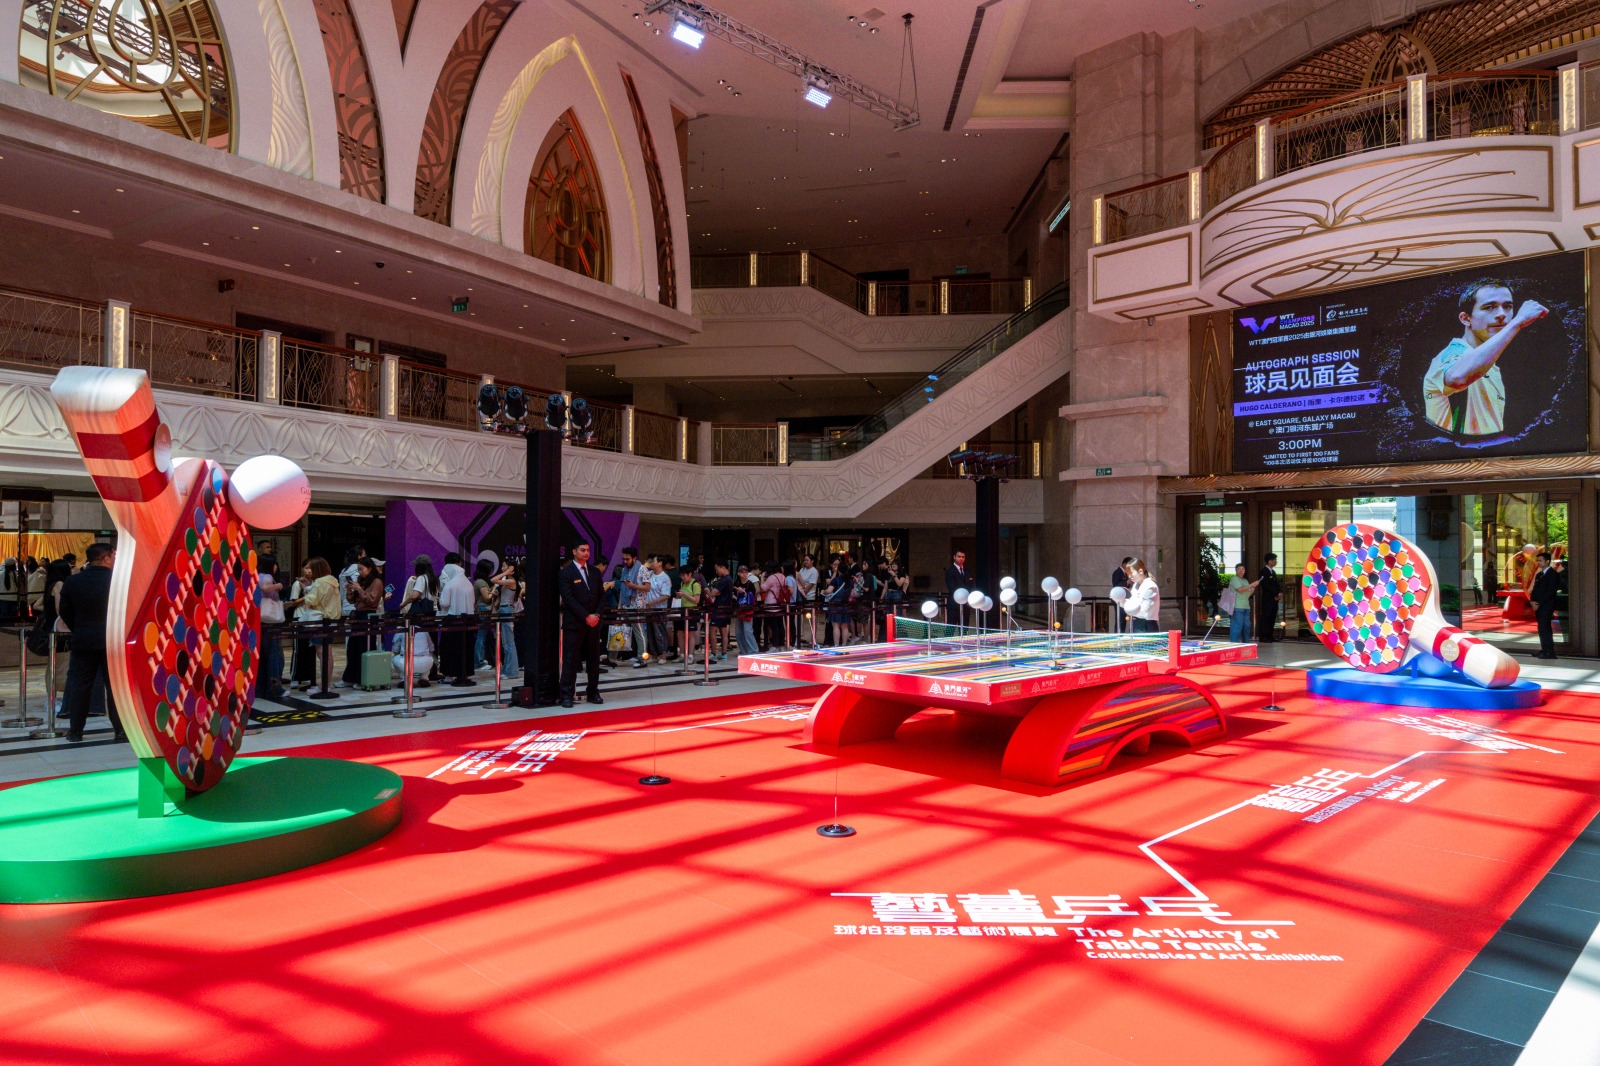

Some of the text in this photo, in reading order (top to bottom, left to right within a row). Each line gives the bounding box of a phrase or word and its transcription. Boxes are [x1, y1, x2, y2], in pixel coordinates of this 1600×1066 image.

[1280, 315, 1315, 324] CHAMPIONS
[1280, 322, 1300, 330] MACAO
[1245, 349, 1360, 372] AUTOGRAPH SESSION
[1244, 362, 1360, 394] 球员见面会
[1240, 400, 1302, 412] HUGO CALDERANO
[1273, 417, 1301, 425] SQUARE,
[1330, 412, 1356, 420] MACAU
[1278, 439, 1322, 450] 3:00PM
[834, 924, 1059, 936] 球拍珍品及藝術展覽
[1067, 927, 1281, 942] The Artistry of
[1076, 939, 1268, 951] Table Tennis
[1086, 951, 1344, 962] Collectables & Art Exhibition
